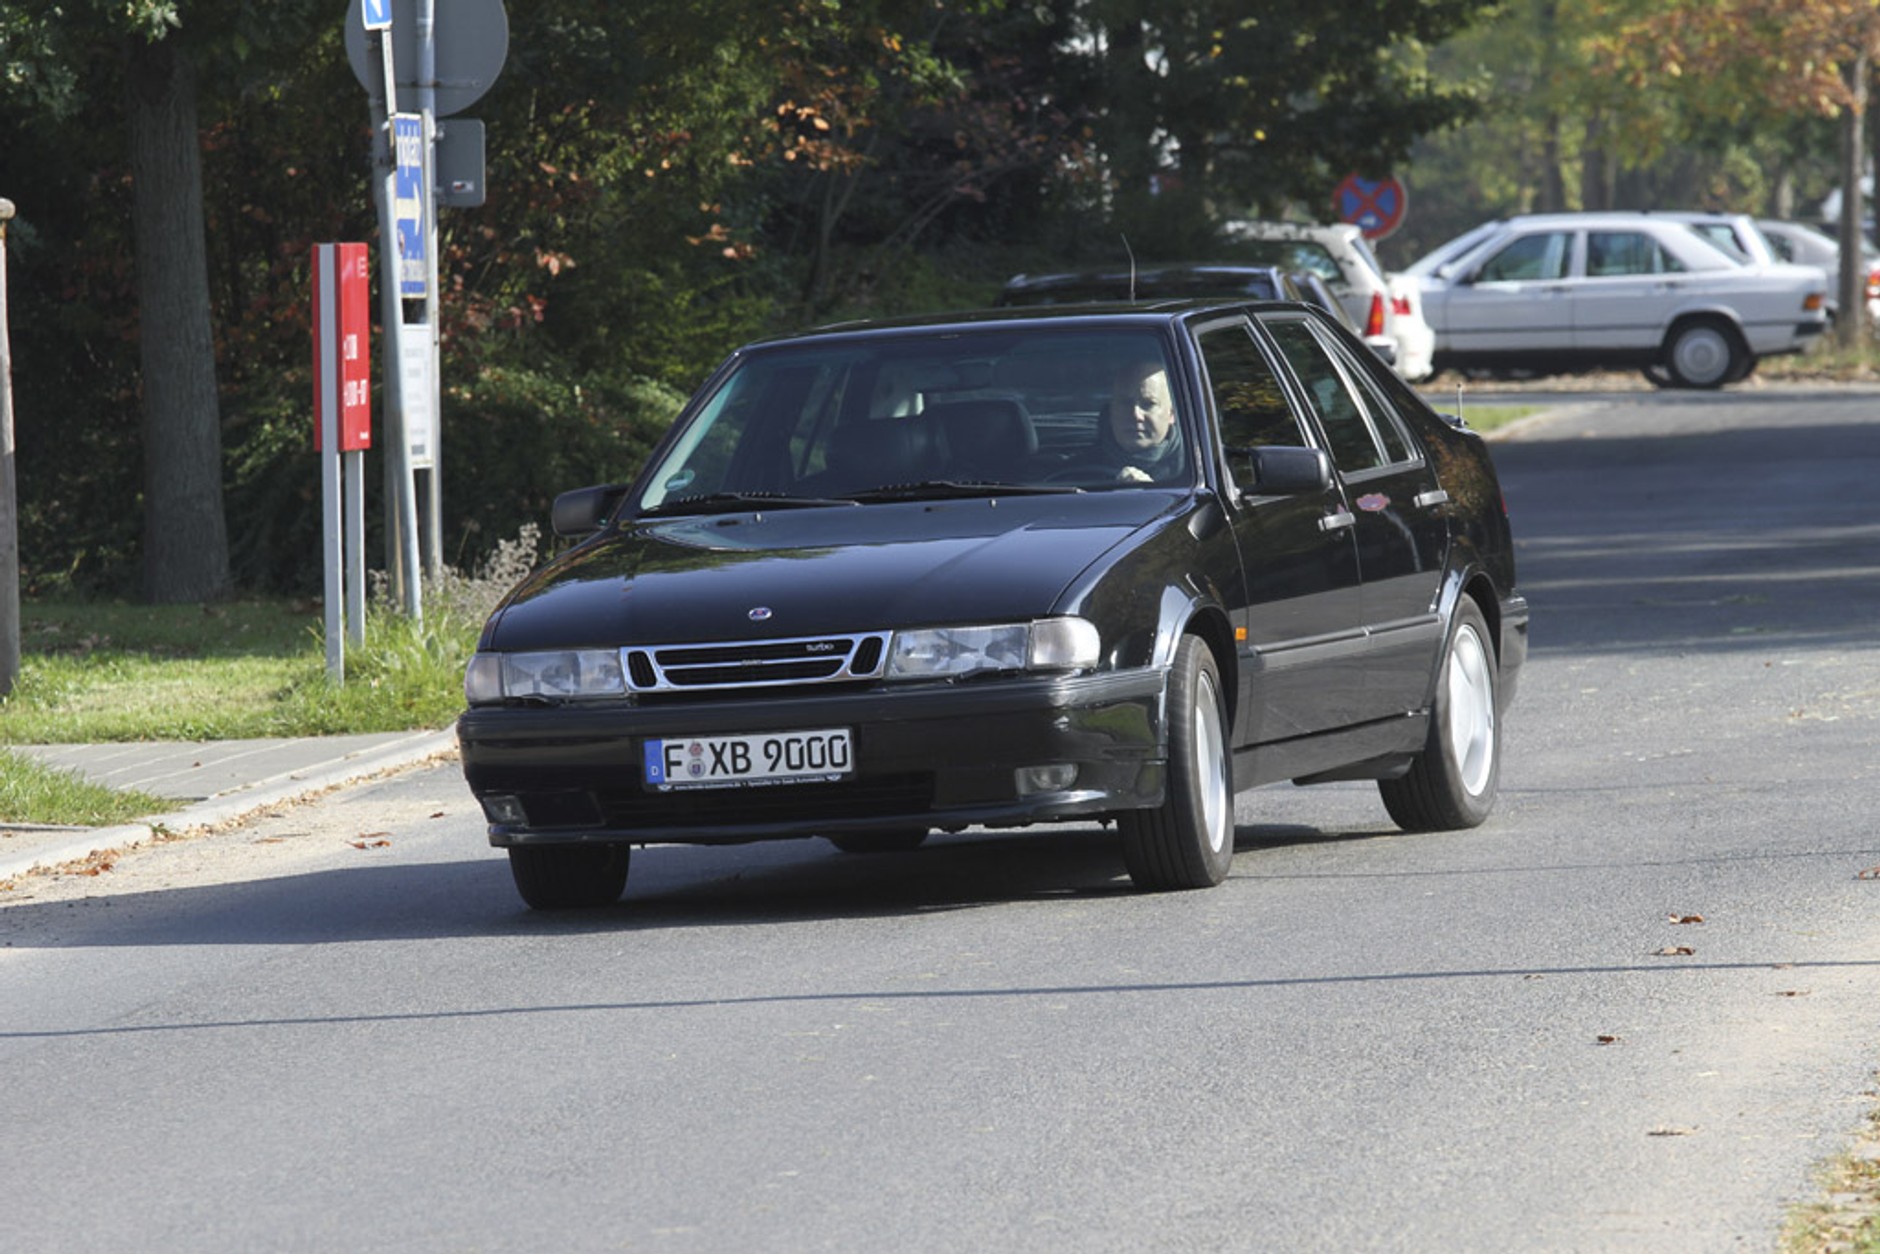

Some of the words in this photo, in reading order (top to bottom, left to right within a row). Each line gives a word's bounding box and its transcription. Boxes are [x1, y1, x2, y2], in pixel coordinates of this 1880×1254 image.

[806, 643, 834, 651] turbo
[664, 744, 684, 778] F
[709, 742, 752, 776] XB
[763, 735, 848, 772] 9000
[651, 765, 659, 776] D
